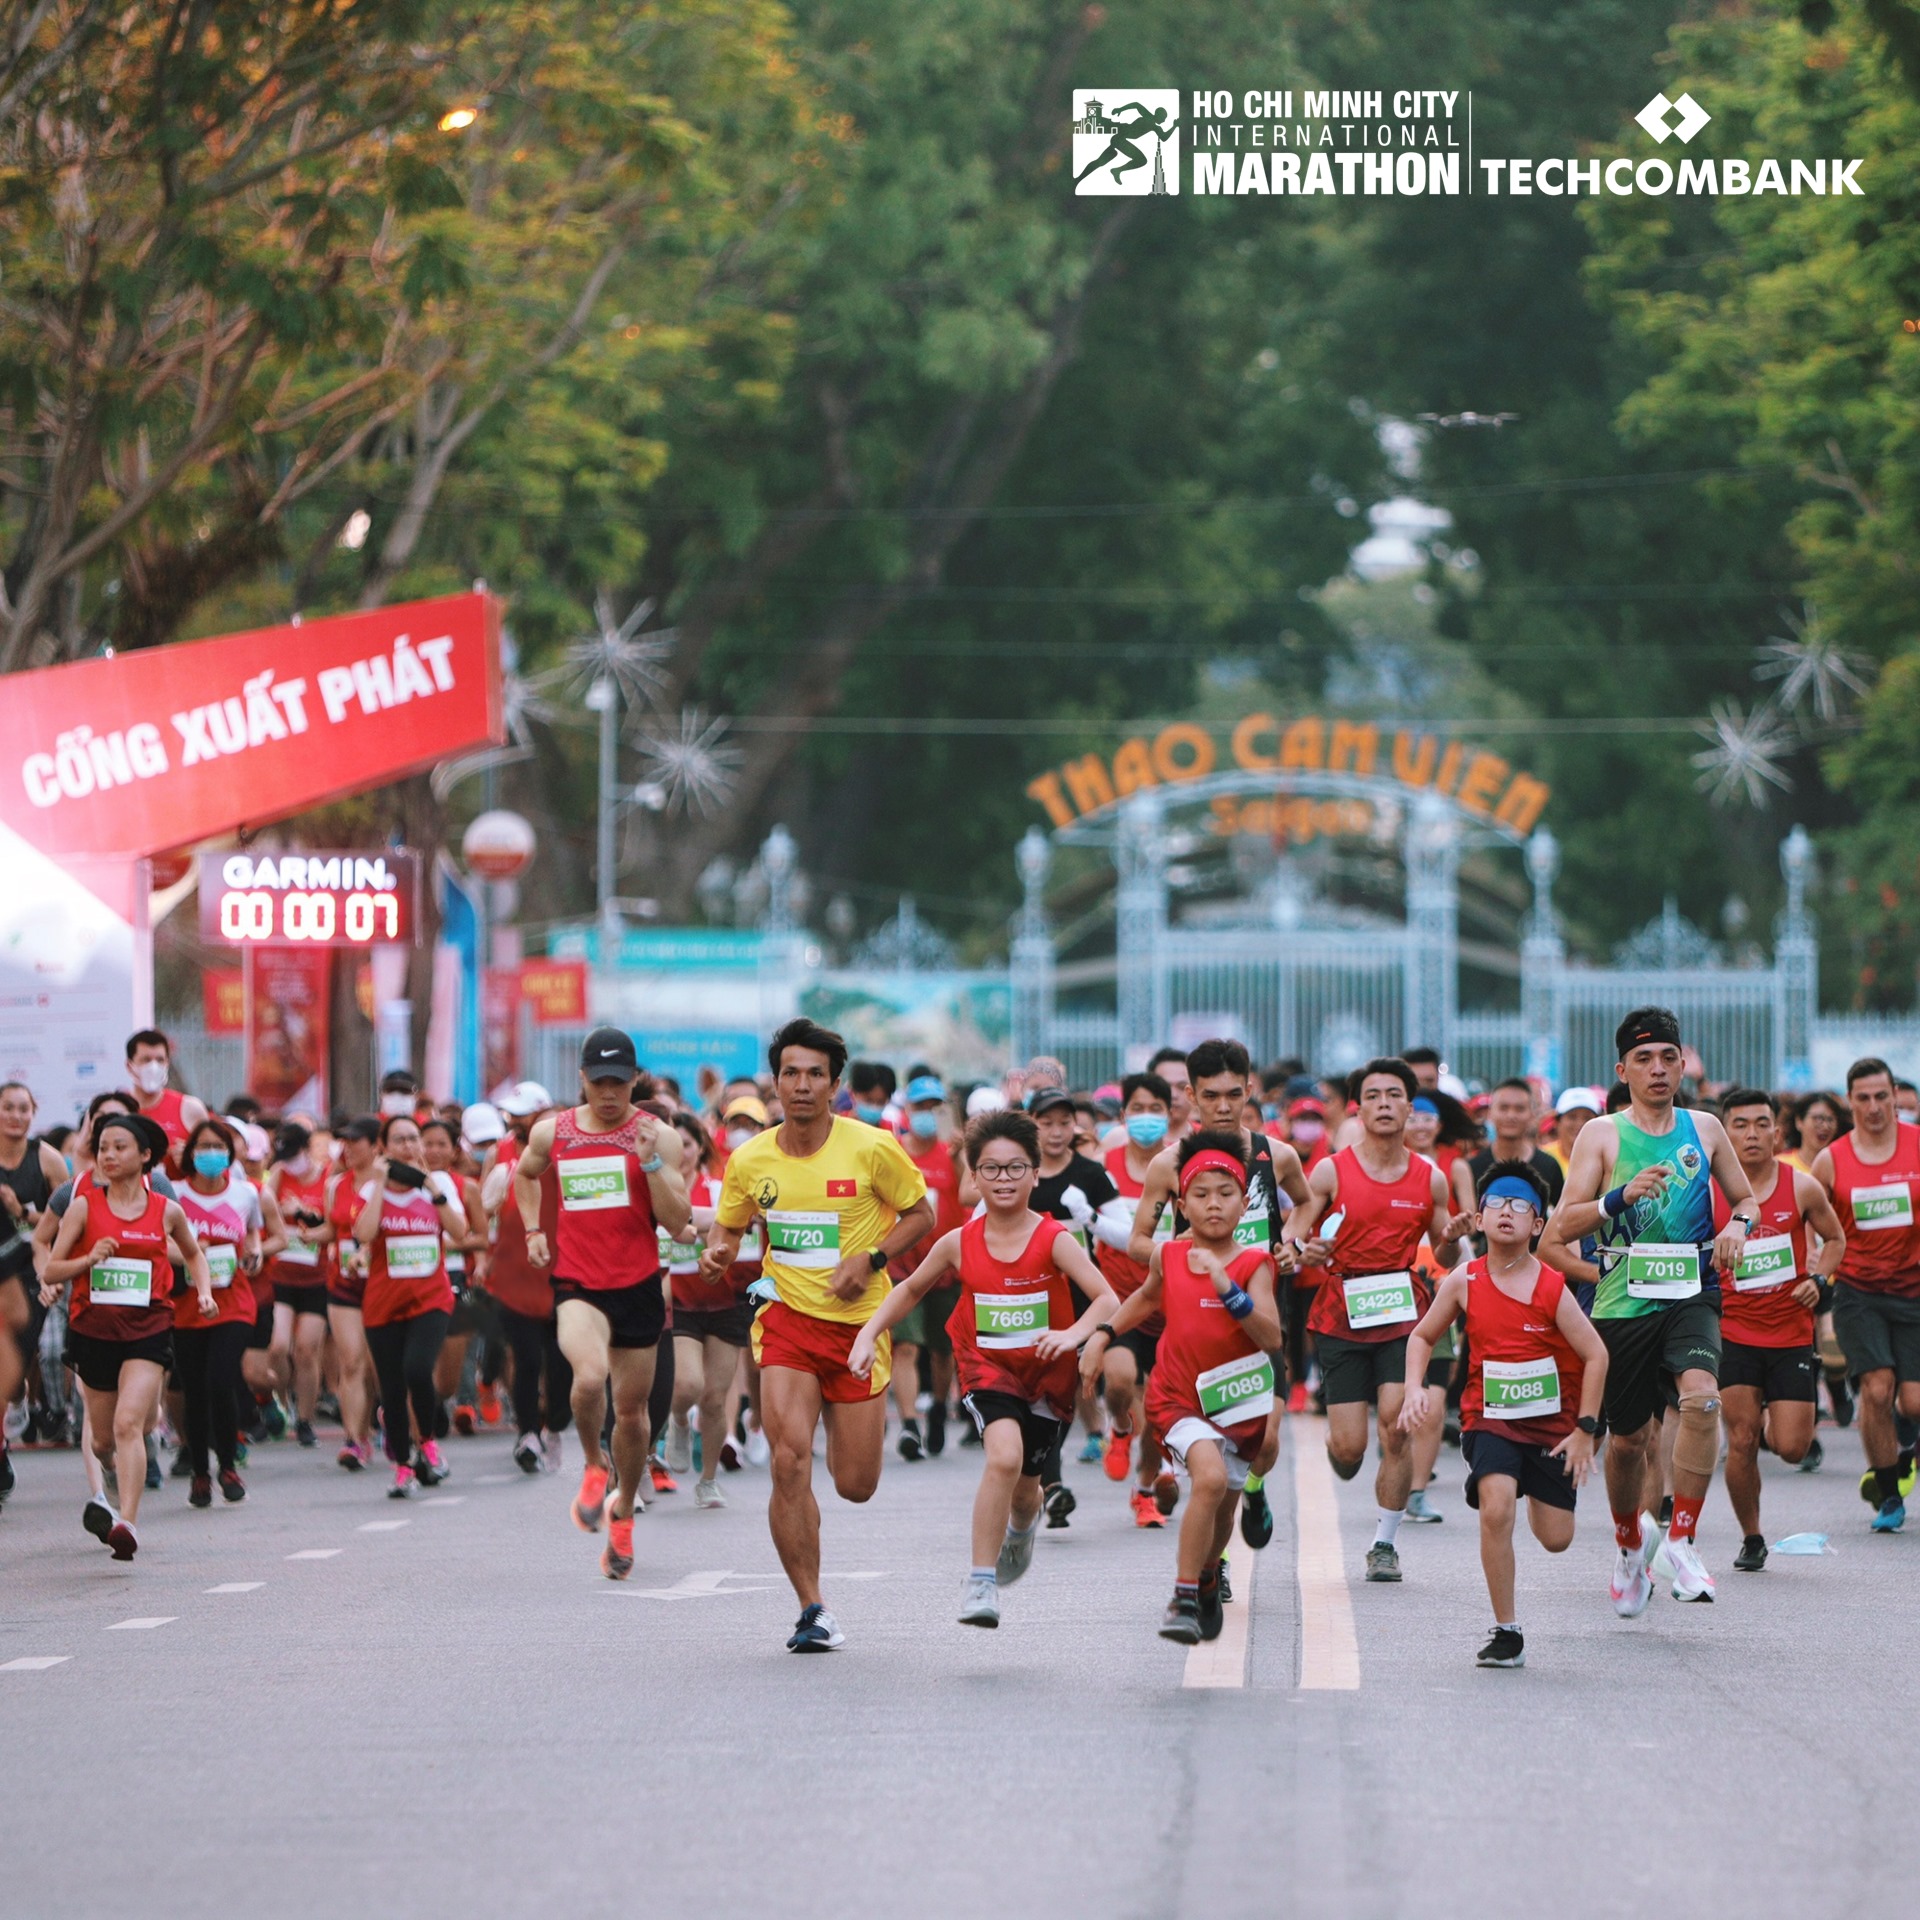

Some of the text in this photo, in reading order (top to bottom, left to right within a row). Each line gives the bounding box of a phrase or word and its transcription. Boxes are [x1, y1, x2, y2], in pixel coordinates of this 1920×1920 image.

[171, 668, 310, 768] XUẤT
[317, 633, 456, 724] PHÁT
[1232, 712, 1379, 775] CAM
[222, 855, 387, 891] GARMIN
[568, 1175, 617, 1194] 36045
[1864, 1199, 1899, 1216] 7466
[781, 1228, 824, 1247] 7720
[1645, 1261, 1686, 1278] 7019
[1744, 1253, 1782, 1273] 7334
[102, 1271, 137, 1287] 7187
[1356, 1291, 1404, 1311] 34229
[989, 1309, 1035, 1328] 7669
[1216, 1373, 1265, 1402] 7089
[1499, 1381, 1544, 1400] 7088
